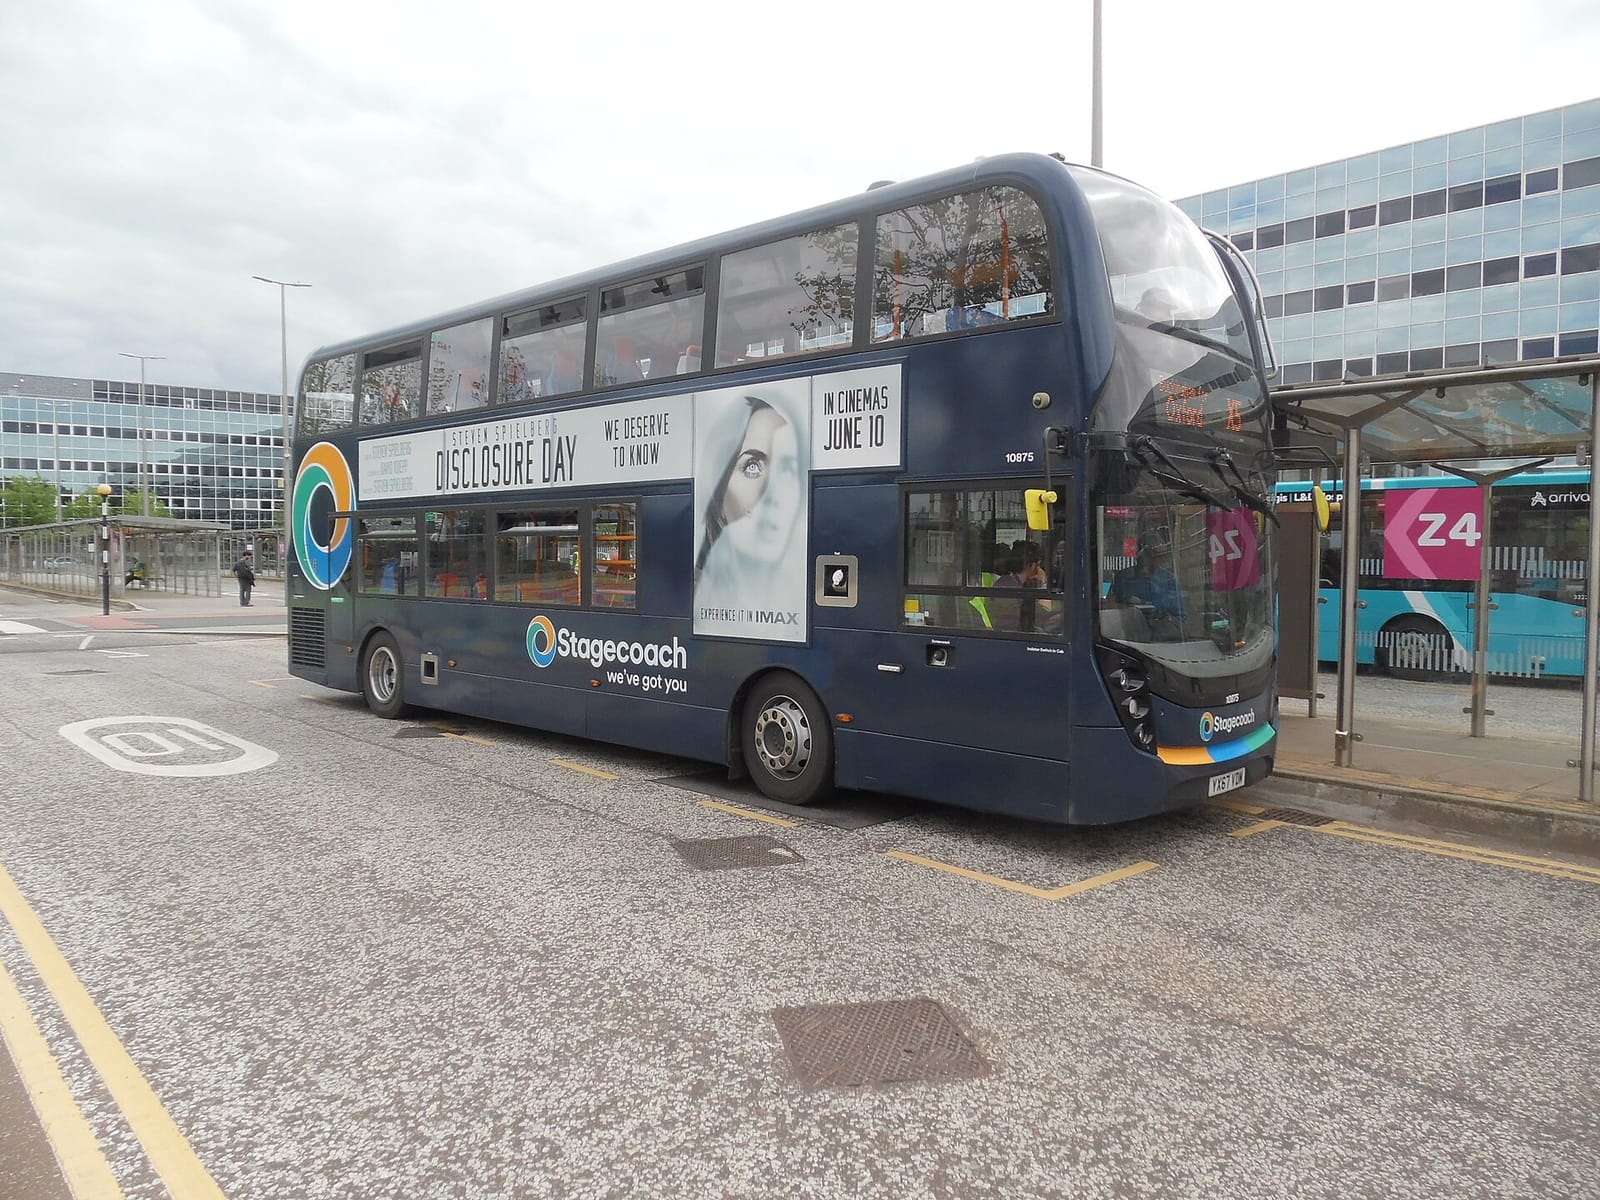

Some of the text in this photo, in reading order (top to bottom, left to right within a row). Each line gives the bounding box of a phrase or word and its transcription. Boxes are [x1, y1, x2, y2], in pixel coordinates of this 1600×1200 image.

[823, 386, 889, 415] IN CINEMAS
[452, 416, 559, 447] STEVEN SPIELBERG
[603, 413, 669, 442] WE DESERVE
[823, 414, 885, 451] JUNE 10
[436, 435, 578, 491] DISCLOSURE DAY
[613, 442, 660, 468] TO KNOW
[1005, 452, 1034, 463] 10875
[1548, 491, 1591, 503] arriva
[1418, 513, 1481, 547] Z4
[700, 607, 799, 625] EXPERIENCE IT IN IMAX
[557, 628, 687, 669] Stagecoach
[606, 669, 687, 694] we've got you
[1213, 708, 1255, 732] Stagecoach
[1212, 775, 1230, 793] YX67
